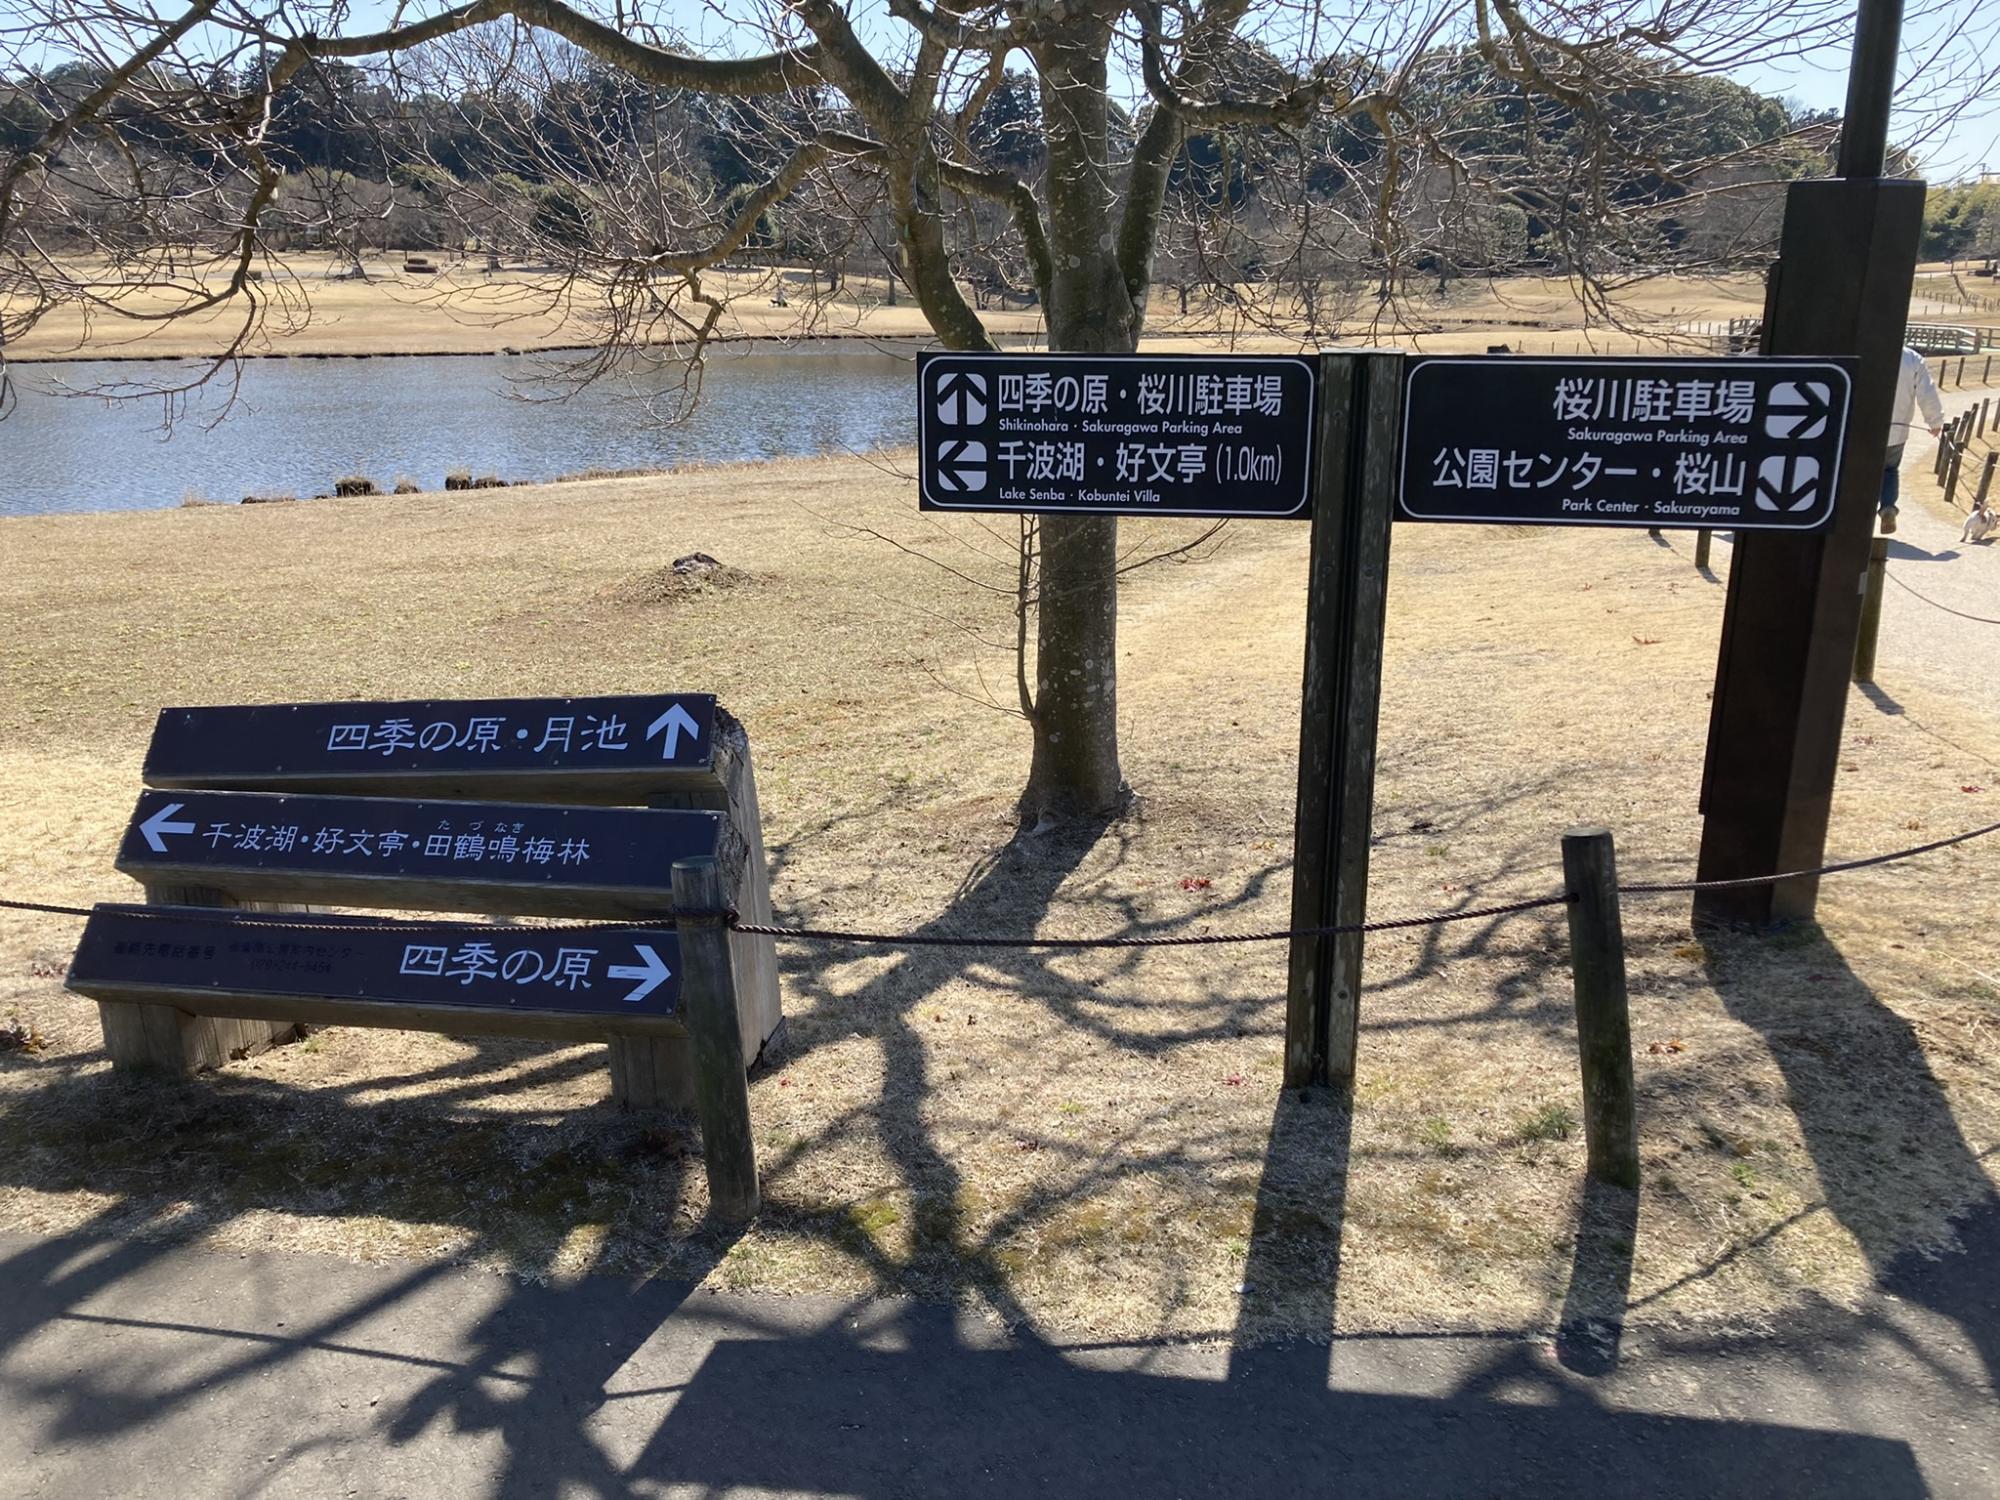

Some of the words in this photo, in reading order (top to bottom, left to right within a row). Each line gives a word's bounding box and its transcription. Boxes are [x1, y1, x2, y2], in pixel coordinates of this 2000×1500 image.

[999, 373, 1282, 416] 四季の原・桜川駐車場
[1553, 378, 1755, 423] 桜川駐車場
[1000, 418, 1068, 431] Shikinohara
[1082, 418, 1158, 436] Sakuragawa
[1163, 420, 1208, 436] Parking
[1213, 422, 1242, 433] Area
[1568, 427, 1652, 444] Sakuragawa
[1657, 429, 1709, 446] Parking
[1713, 431, 1747, 443] Area
[998, 441, 1207, 483] 千波湖・好文亭
[1217, 444, 1281, 484] (1.0km)
[1433, 447, 1746, 495] 公園センター・桜山
[1000, 487, 1025, 499] Lake
[1030, 488, 1064, 500] Senba
[1079, 489, 1129, 501] Kobuntei
[1134, 490, 1160, 502] Villa
[1563, 498, 1592, 511] Park
[1597, 500, 1639, 512] Center
[1654, 501, 1739, 517] Sakurayama
[327, 717, 628, 756] 四季の原・月池
[203, 822, 590, 865] 千波湖・好文亭・田鶴鳴梅林
[400, 943, 599, 990] 四季の原
